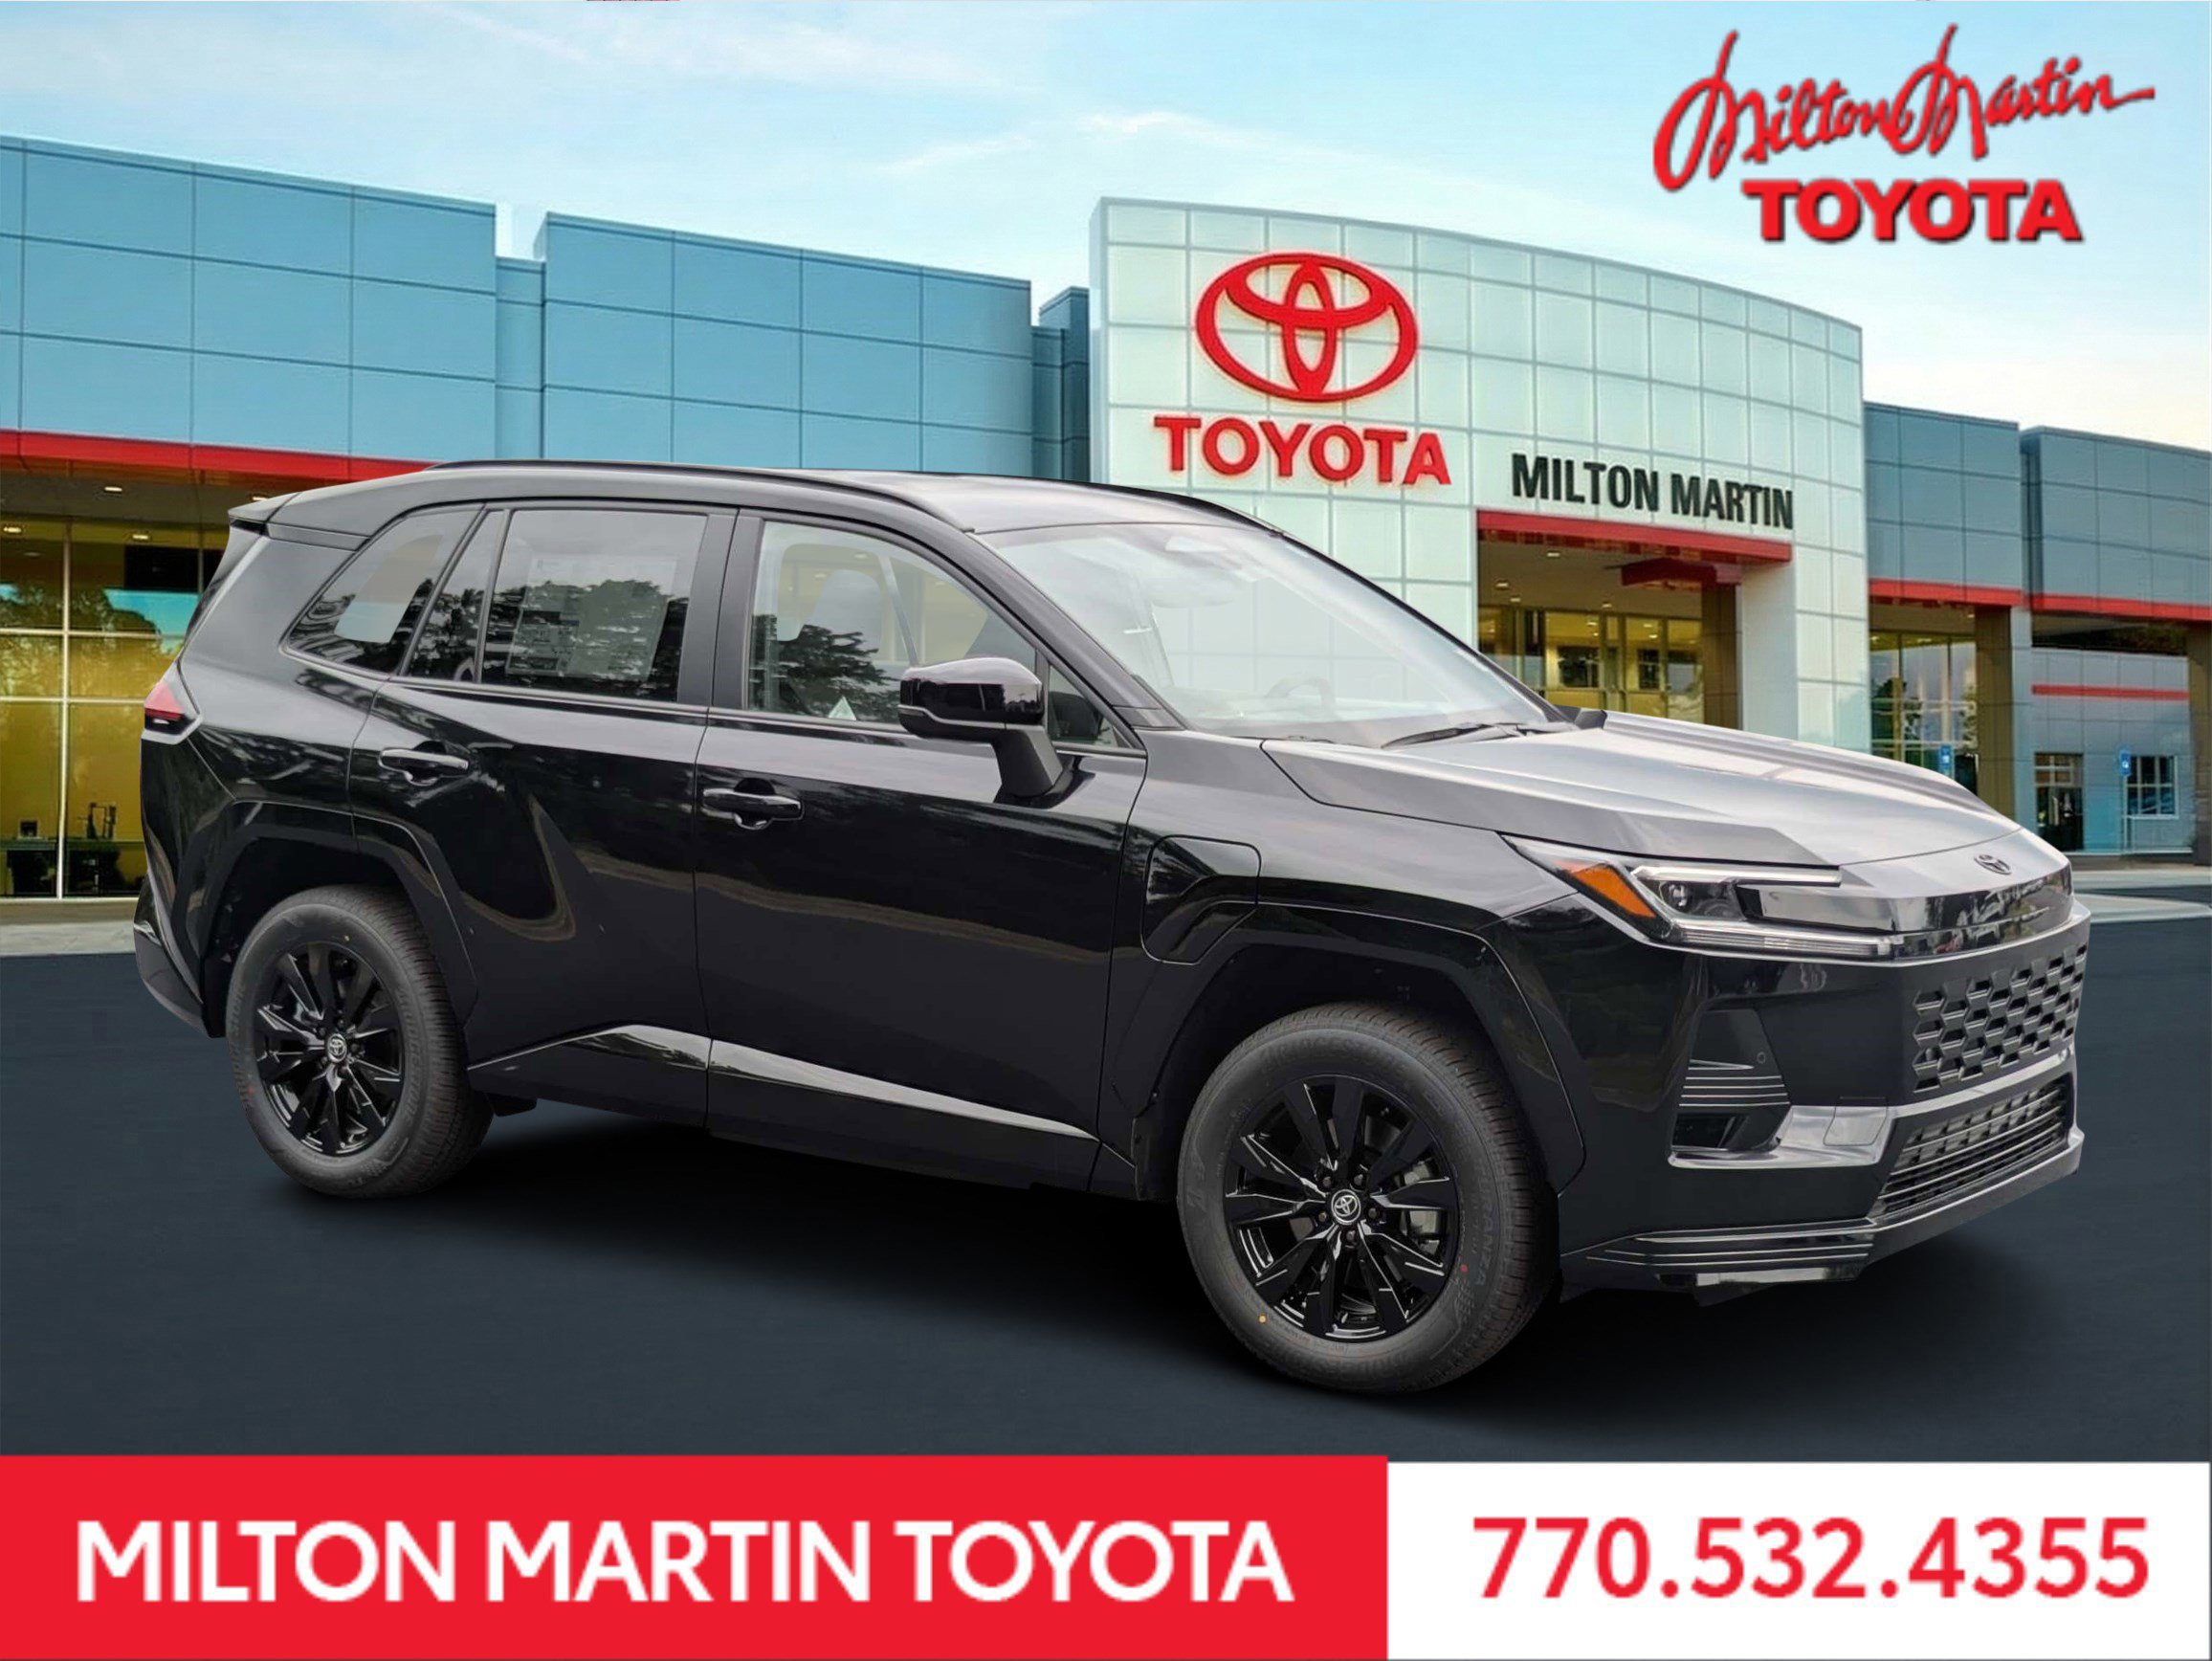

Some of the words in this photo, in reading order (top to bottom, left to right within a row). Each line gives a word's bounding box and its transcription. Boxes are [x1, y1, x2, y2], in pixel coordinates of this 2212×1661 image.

[1154, 415, 1451, 486] TOYOTA
[1512, 452, 1660, 512] MILTON
[1670, 474, 1794, 531] MARTIN
